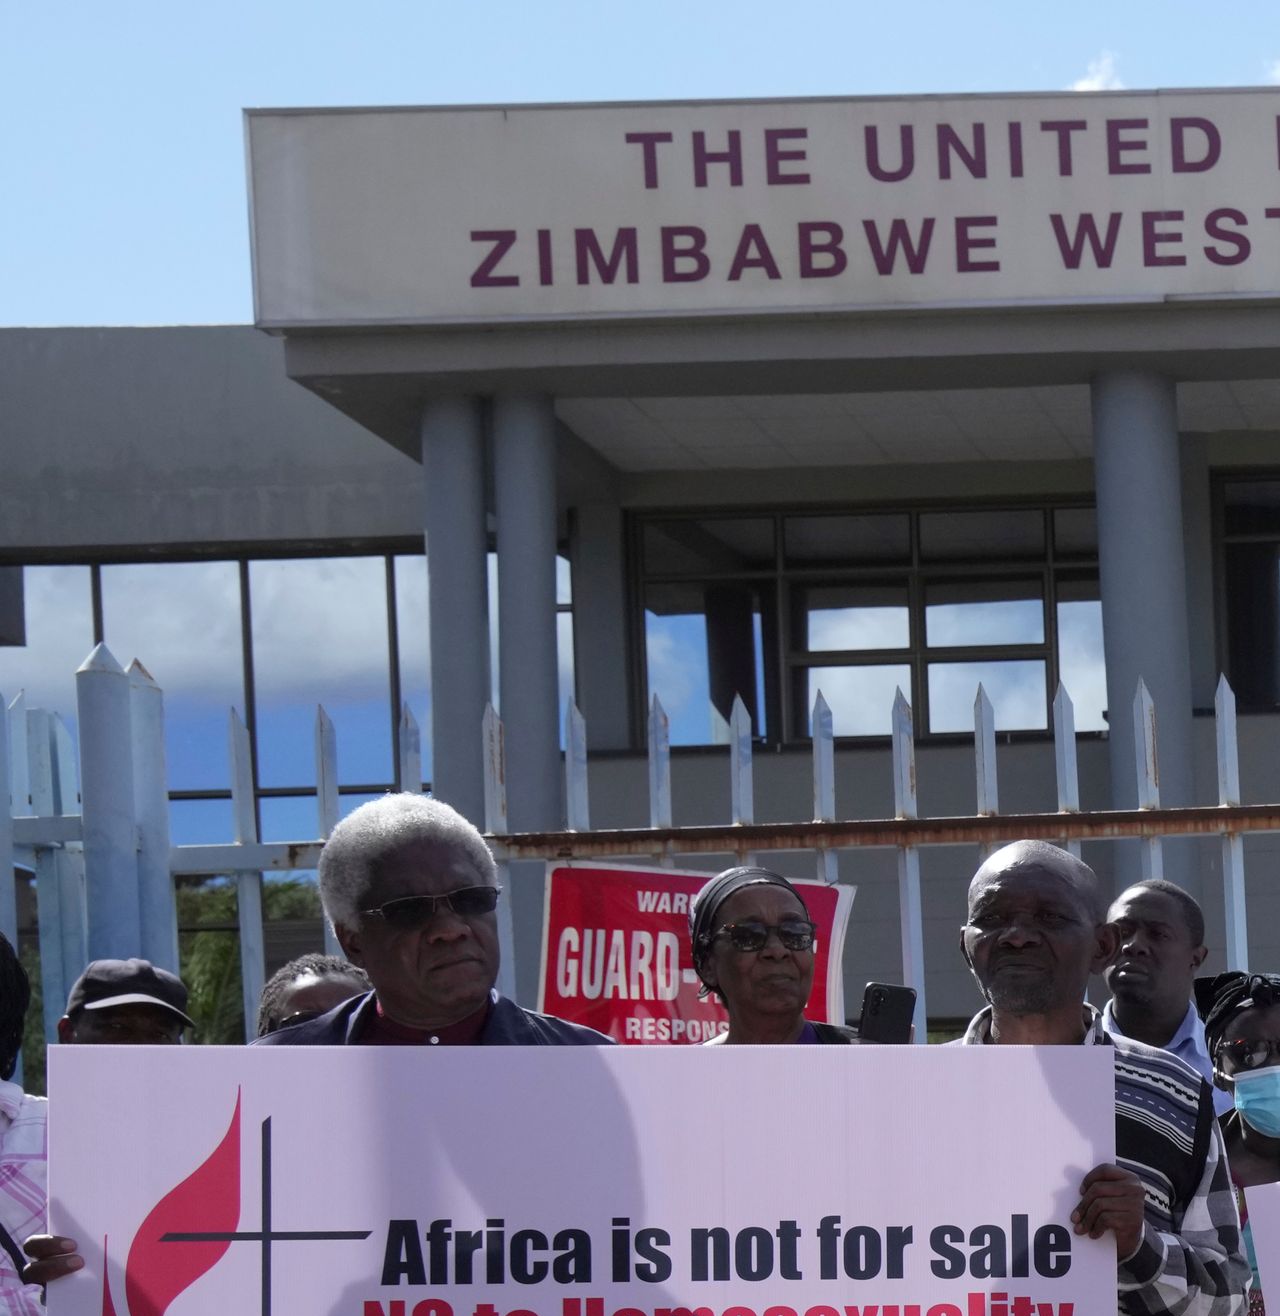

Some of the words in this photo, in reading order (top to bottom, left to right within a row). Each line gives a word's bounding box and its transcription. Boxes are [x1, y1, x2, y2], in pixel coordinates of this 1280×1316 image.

[626, 128, 811, 190] THE
[864, 117, 1222, 183] UNITED
[470, 216, 1001, 288] ZIMBABWE
[637, 891, 697, 915] WAR
[557, 926, 721, 1004] GUARD-
[380, 1218, 592, 1286] Africa
[611, 1217, 672, 1284] is
[690, 1220, 803, 1282] not
[816, 1215, 914, 1281] for
[929, 1215, 1072, 1280] sale
